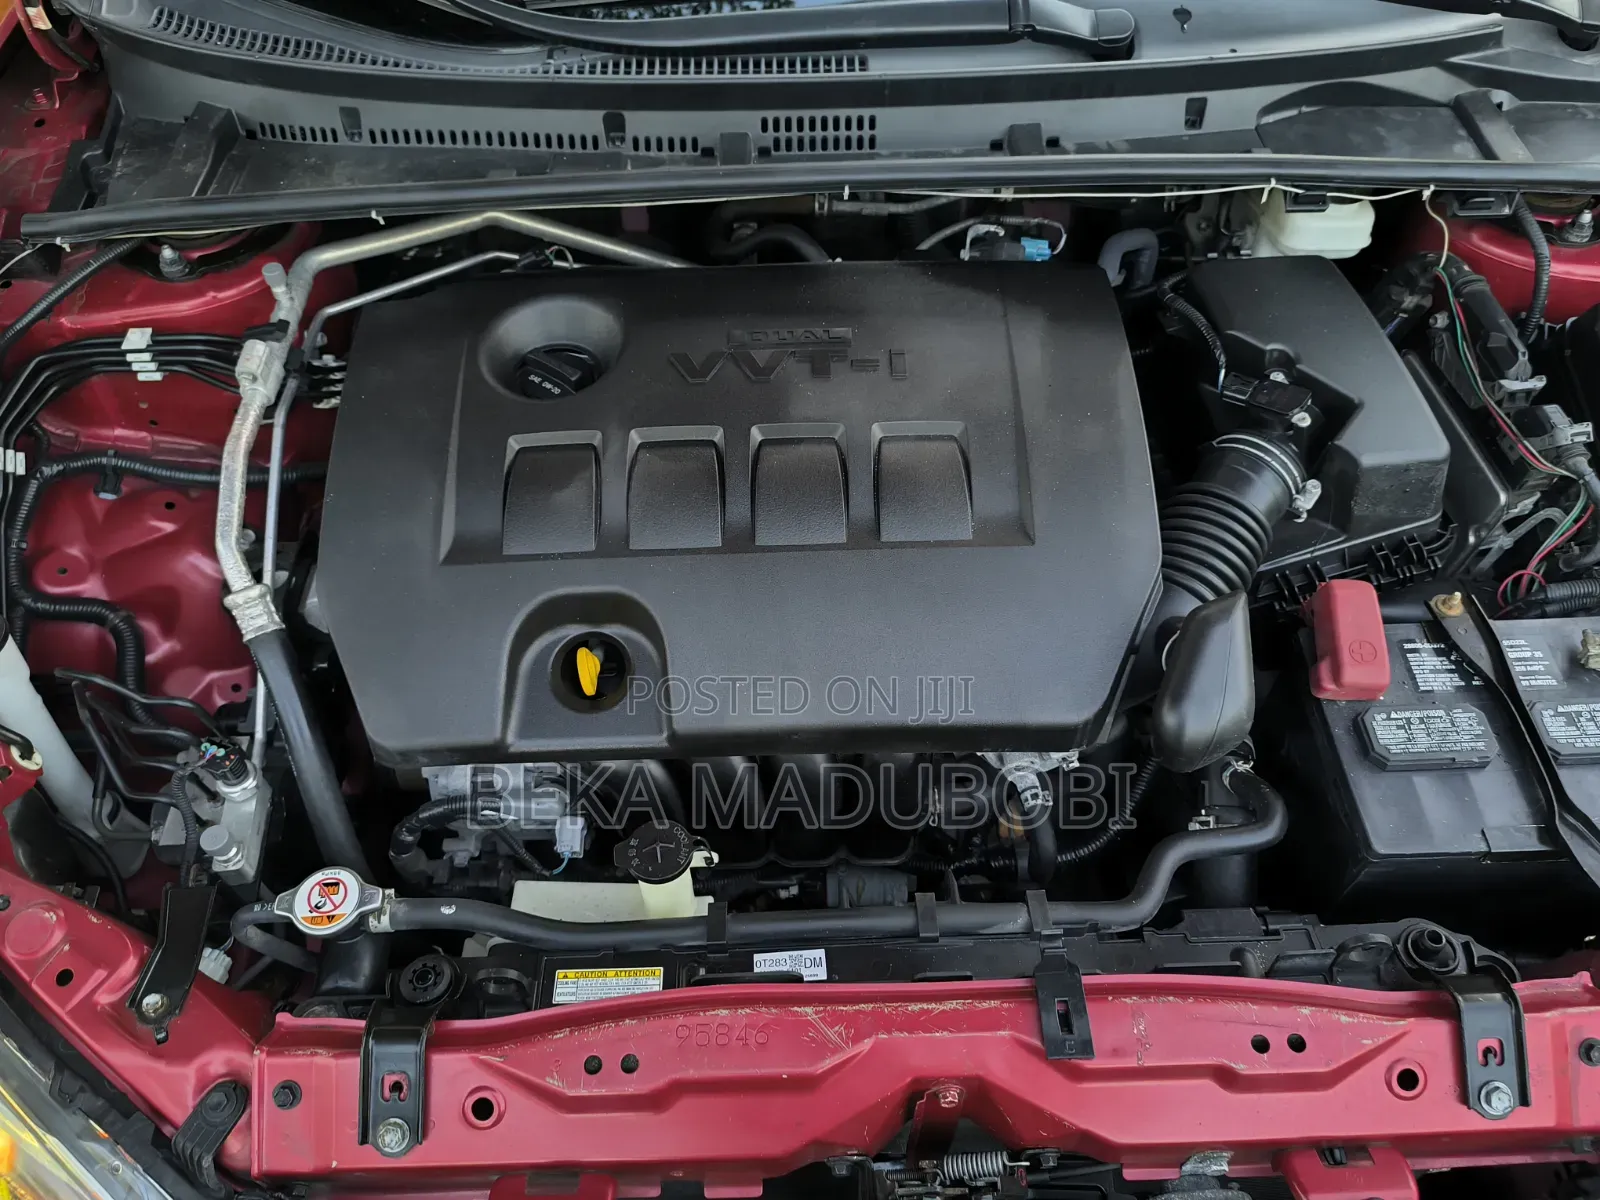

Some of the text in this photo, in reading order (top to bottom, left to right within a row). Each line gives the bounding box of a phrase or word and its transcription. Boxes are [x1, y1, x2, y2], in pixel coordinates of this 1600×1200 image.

[748, 328, 846, 343] DUAL
[528, 374, 562, 395] SAE 0W-20
[1507, 651, 1532, 659] GROUP
[673, 826, 690, 865] COOLANT
[803, 956, 823, 969] DM
[574, 969, 656, 978] CAUTION ATTENTION
[675, 1022, 769, 1048] 95846
